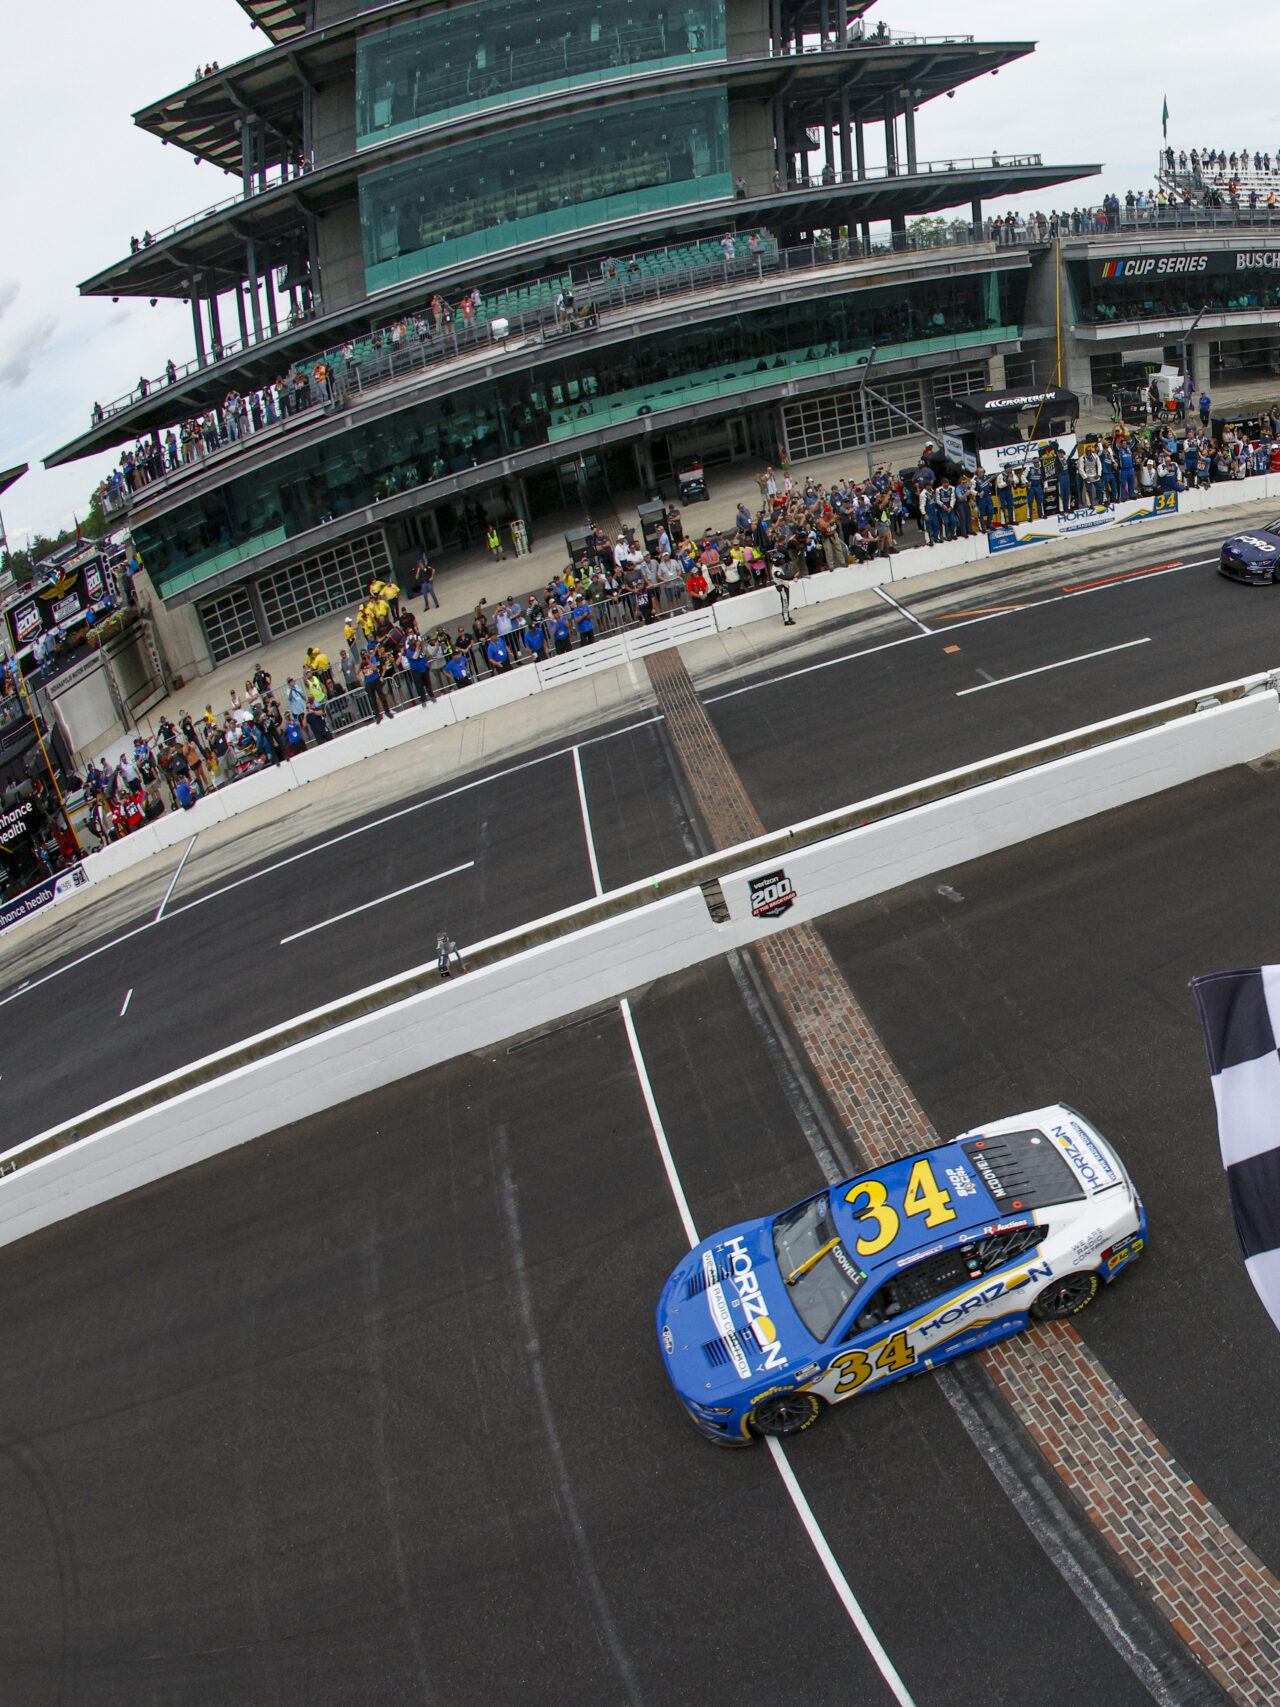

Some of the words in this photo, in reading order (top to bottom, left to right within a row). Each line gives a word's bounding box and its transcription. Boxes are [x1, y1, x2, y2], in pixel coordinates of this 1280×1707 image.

[1124, 257, 1155, 276] CUP
[1156, 255, 1208, 273] SERIES
[1057, 503, 1115, 524] HORIZON
[1155, 492, 1176, 511] 34
[1234, 535, 1276, 552] FORD
[18, 611, 38, 632] 200
[0, 802, 32, 829] nhance
[751, 879, 792, 910] 200
[753, 876, 779, 889] verizon
[0, 905, 26, 926] hance
[26, 889, 53, 911] health
[760, 904, 770, 913] THE
[1051, 1125, 1104, 1190] HORIZON
[945, 1168, 969, 1197] SHOP
[957, 1165, 977, 1195] LOCAL
[844, 1158, 957, 1257] 34
[1077, 1234, 1104, 1255] RADIO
[831, 1244, 861, 1285] CDOWELL
[713, 1287, 729, 1317] RADIO
[724, 1235, 788, 1371] HORIZON
[918, 1261, 1053, 1337] HORIZON
[830, 1330, 916, 1395] 34
[750, 1385, 795, 1404] GOODYEAR
